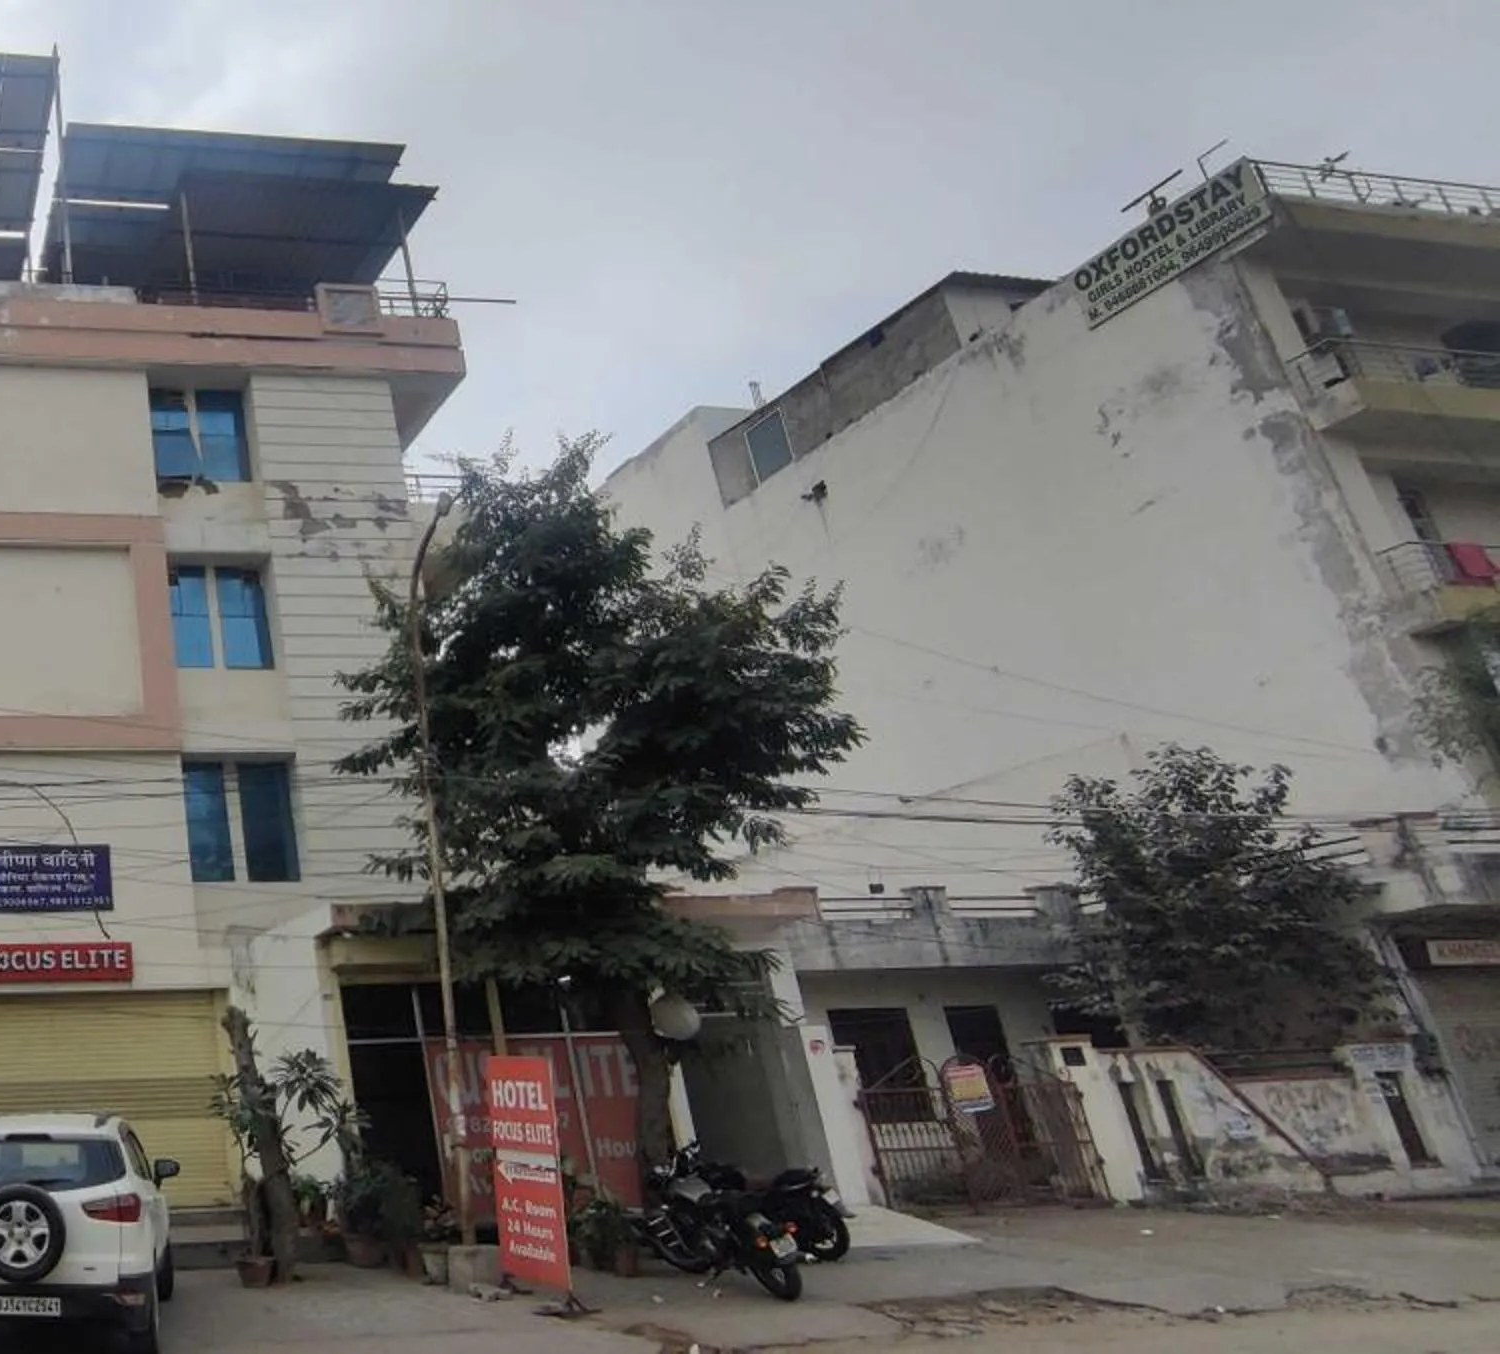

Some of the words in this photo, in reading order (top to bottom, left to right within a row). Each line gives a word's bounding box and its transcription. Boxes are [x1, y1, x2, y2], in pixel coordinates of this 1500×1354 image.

[1074, 164, 1243, 291] OXFORDSTAY
[1087, 273, 1123, 303] GIRLS
[1123, 243, 1174, 280] HOSTEL
[1187, 192, 1246, 238] LIBRARY
[42, 849, 96, 868] वादिनी
[61, 950, 128, 969] ELITE
[491, 1079, 549, 1111] HOTEL
[493, 1120, 523, 1142] FOCUS
[525, 1122, 553, 1146] ELITE
[525, 1199, 557, 1219] Room
[507, 1218, 521, 1233] 24
[523, 1220, 555, 1241] Hours
[509, 1239, 557, 1263] Available
